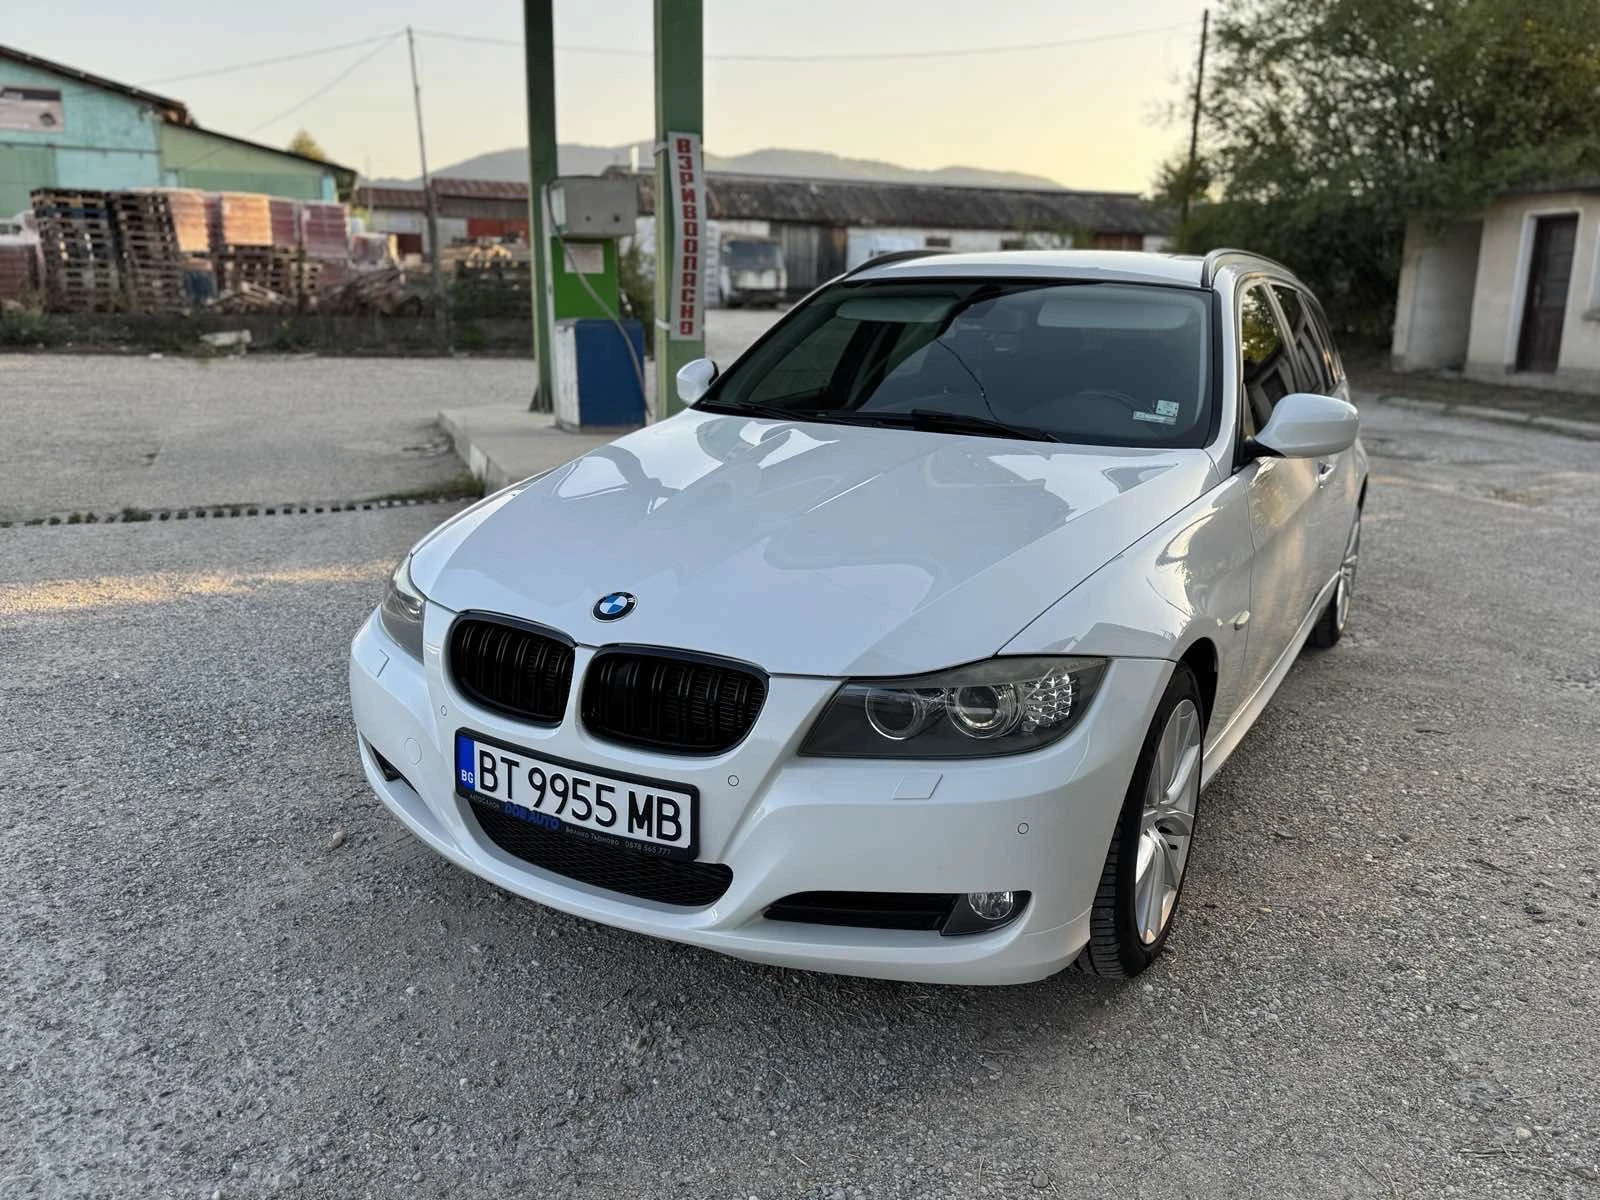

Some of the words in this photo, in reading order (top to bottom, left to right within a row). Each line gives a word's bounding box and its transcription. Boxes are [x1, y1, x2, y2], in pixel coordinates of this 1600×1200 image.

[676, 138, 698, 335] ВЗРИВООПАСНО
[461, 769, 474, 784] BG
[479, 749, 520, 800] BT
[528, 767, 617, 828] 9955
[628, 790, 682, 841] MB
[528, 811, 560, 830] AUTO
